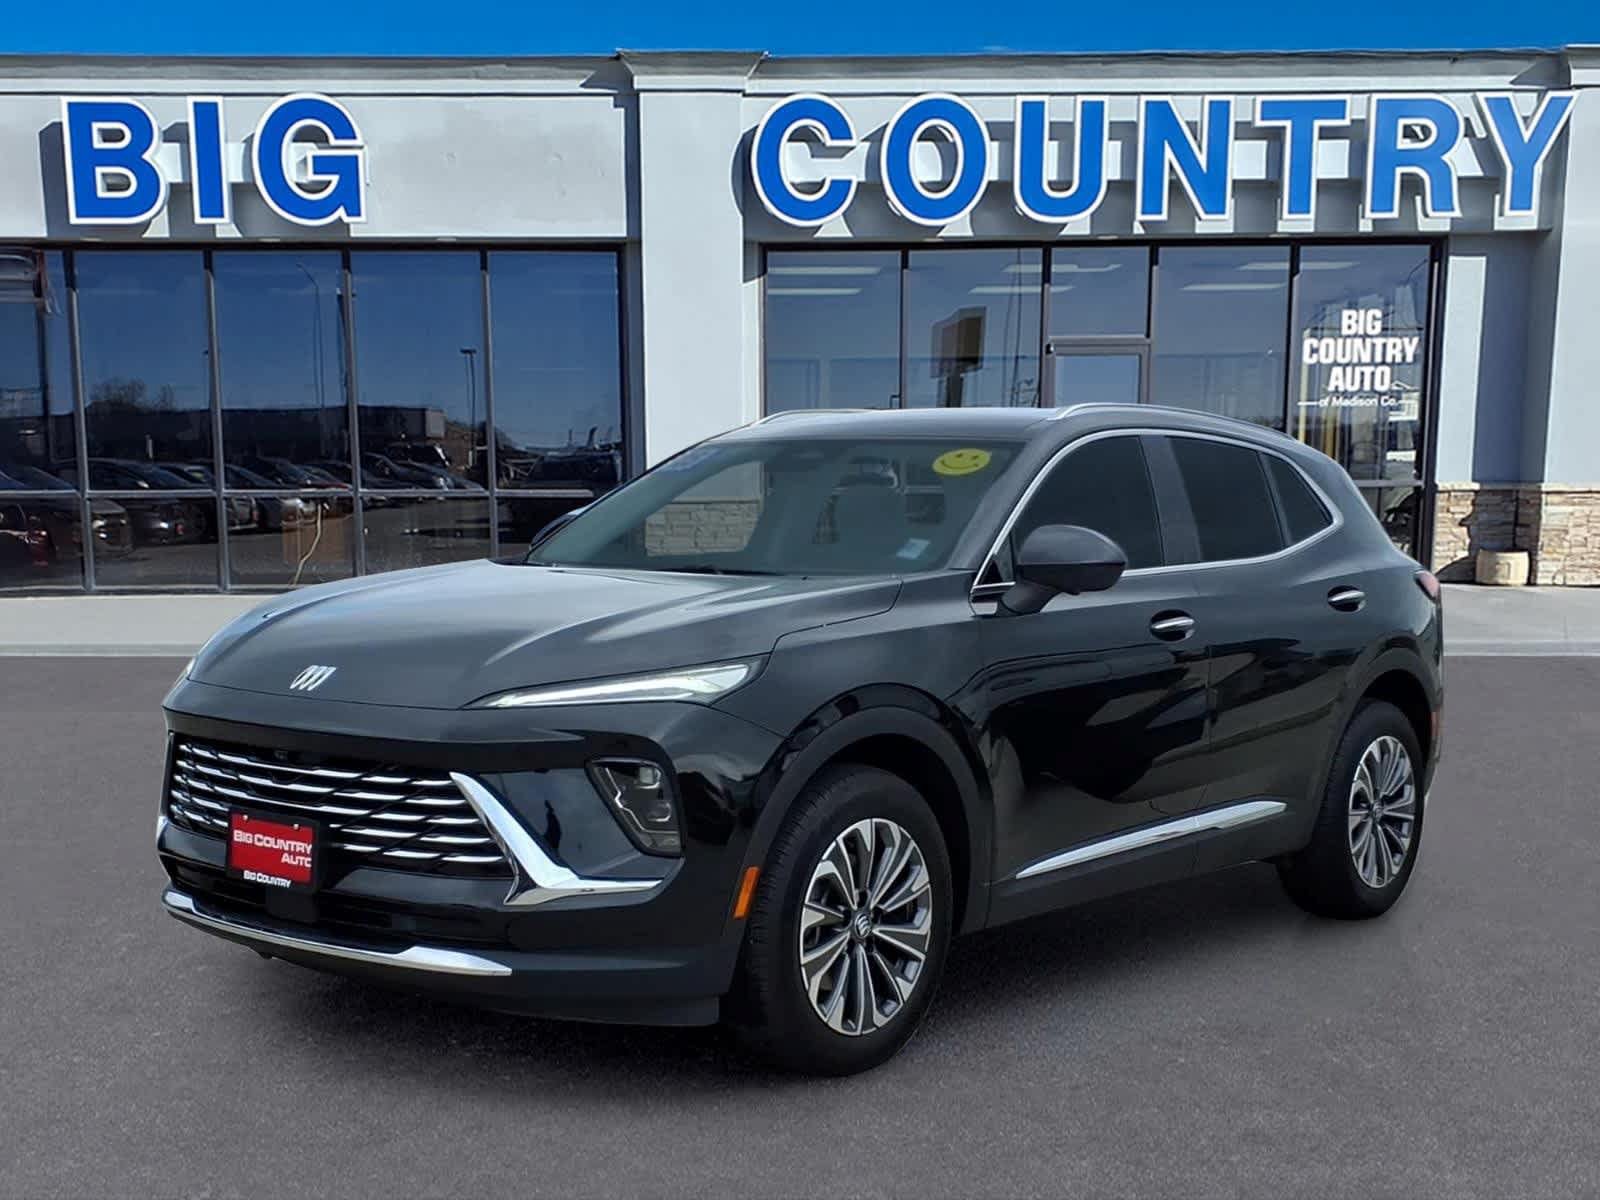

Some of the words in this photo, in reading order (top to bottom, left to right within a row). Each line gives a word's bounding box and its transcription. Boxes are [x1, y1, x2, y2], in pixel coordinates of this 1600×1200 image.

[60, 92, 367, 226] BIG
[751, 90, 1577, 226] COUNTRY
[1341, 309, 1383, 336] BIG
[1302, 337, 1419, 364] COUNTRY
[1327, 366, 1391, 392] AUTO
[1320, 396, 1329, 407] of
[1331, 395, 1378, 407] Madison
[254, 834, 312, 854] COUNTRY
[256, 873, 291, 888] COUNTRY
